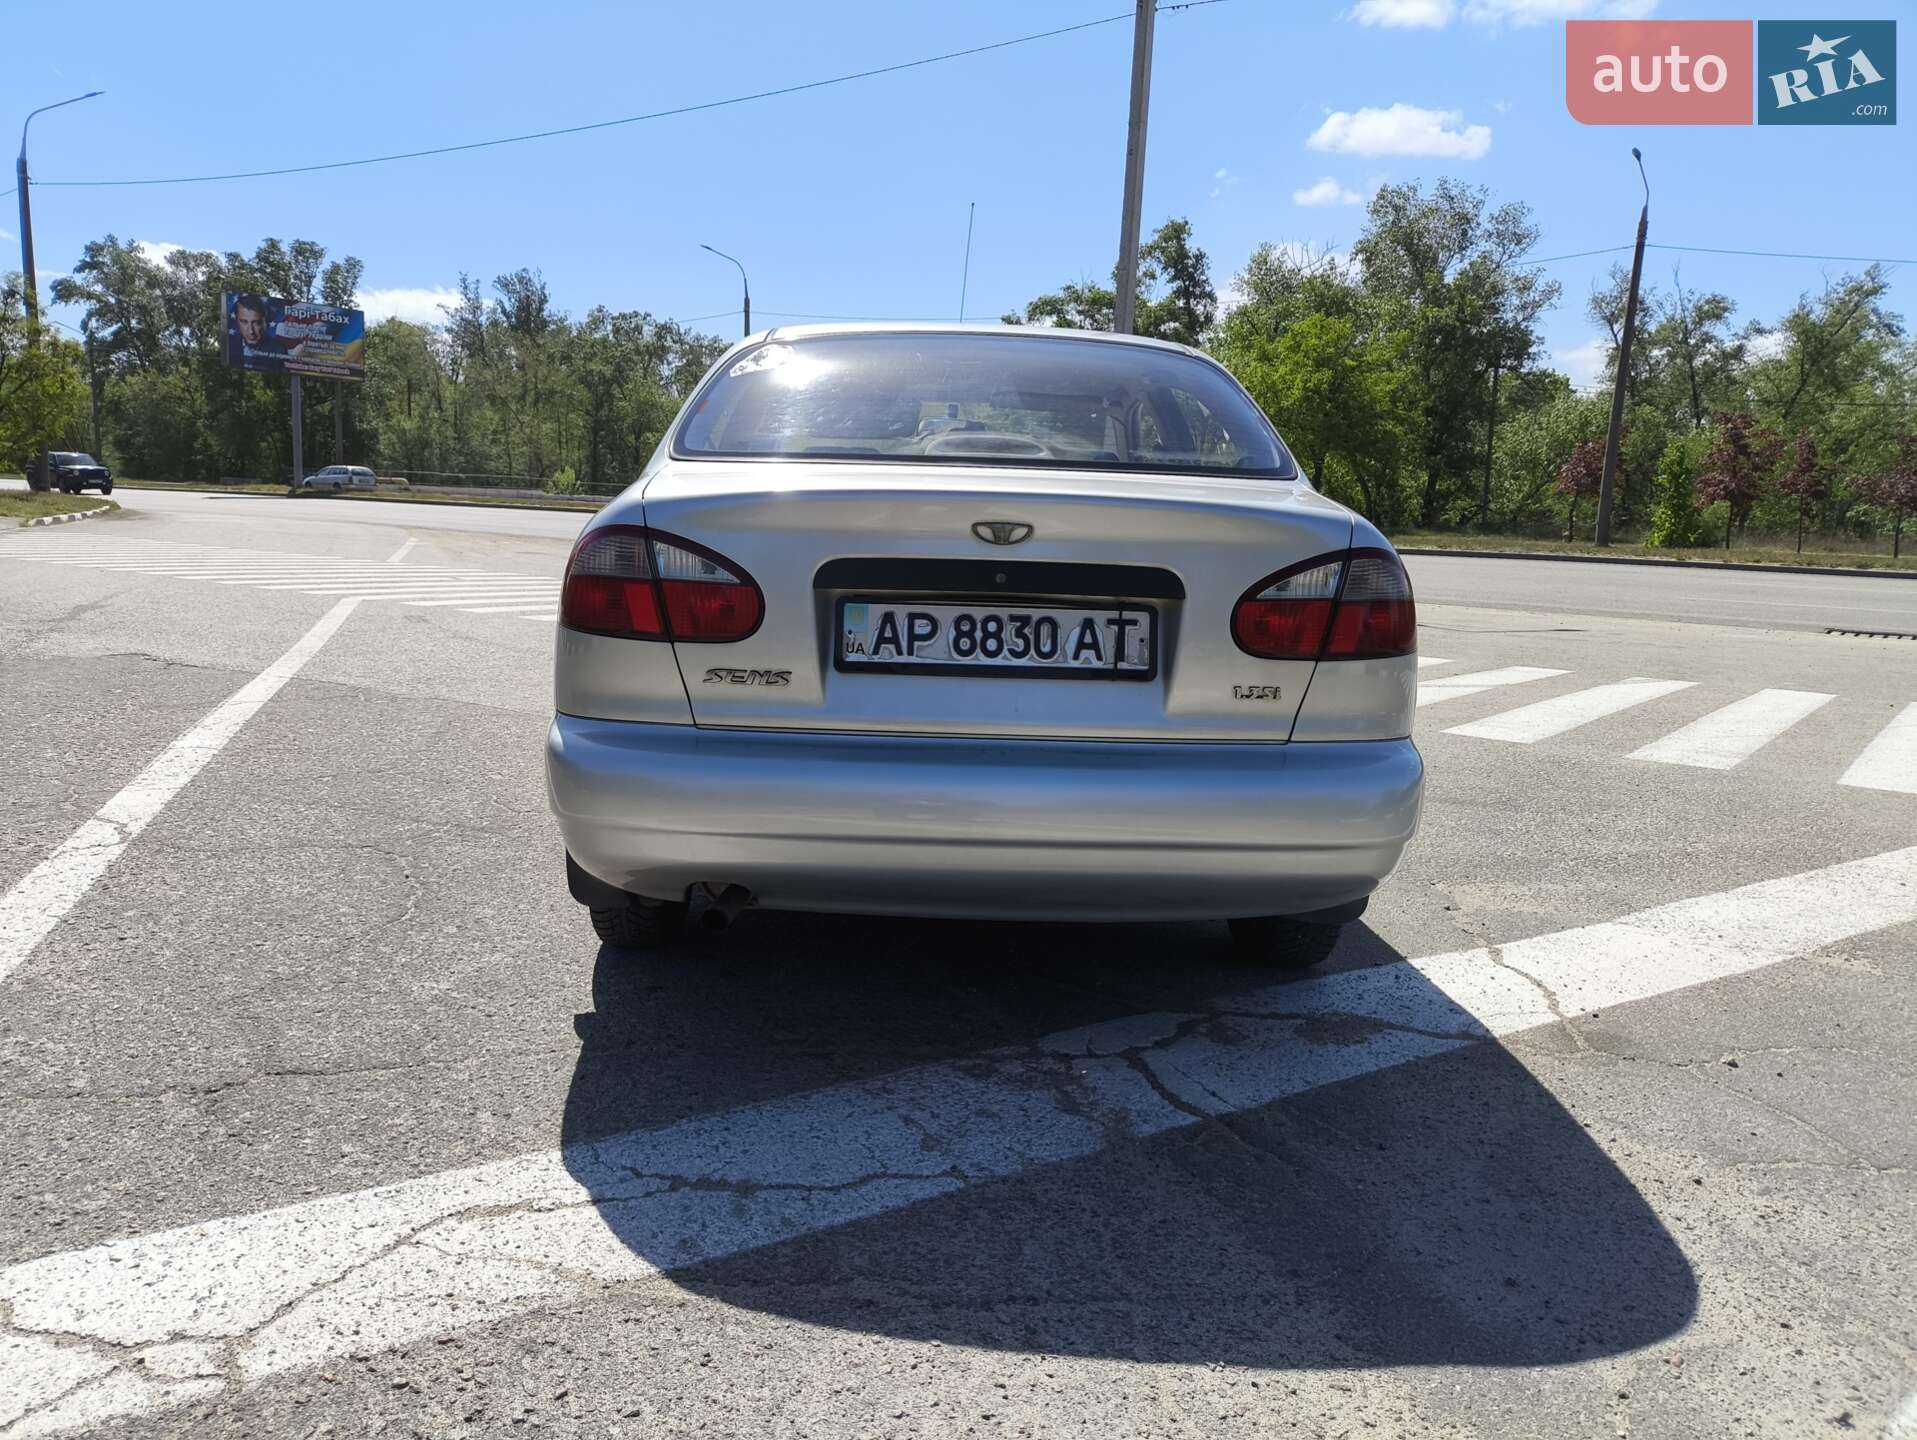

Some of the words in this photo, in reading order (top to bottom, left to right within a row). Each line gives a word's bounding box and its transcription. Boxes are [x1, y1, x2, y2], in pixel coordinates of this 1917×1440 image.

[953, 613, 1061, 660] 8830
[1072, 617, 1139, 662] AT
[846, 642, 865, 655] UA
[702, 668, 793, 687] SENS
